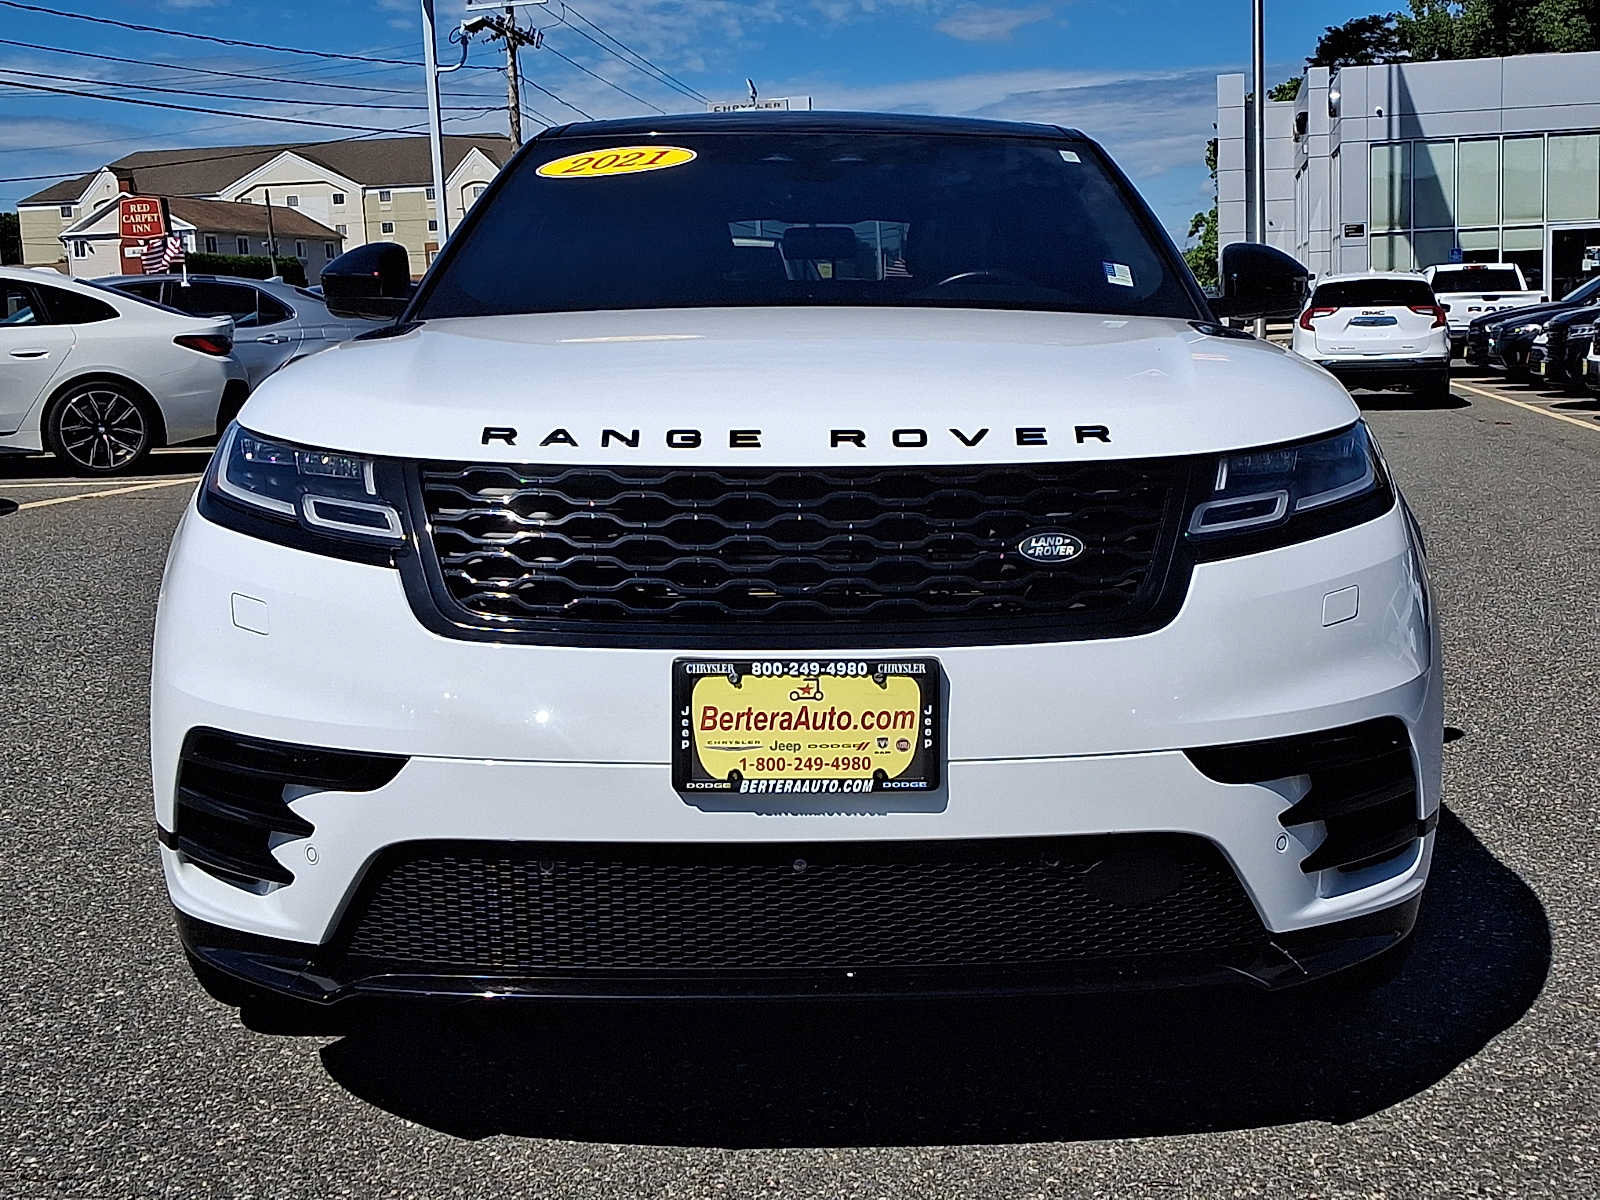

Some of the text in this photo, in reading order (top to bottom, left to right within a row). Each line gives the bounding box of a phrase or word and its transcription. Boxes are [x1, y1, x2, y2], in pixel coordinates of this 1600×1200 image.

[562, 150, 670, 174] 2021
[130, 203, 150, 213] RED
[122, 213, 159, 223] CARPET
[132, 223, 152, 233] INN
[481, 424, 1112, 449] RANGE ROVER
[1030, 536, 1064, 547] LAND
[1034, 545, 1075, 557] ROVER
[685, 663, 736, 674] CHRYSLER
[751, 661, 868, 676] 800-249-4980
[877, 663, 927, 674] CHRYSLER
[700, 705, 916, 731] BerteraAuto.com
[680, 705, 690, 750] Jeep
[923, 704, 933, 749] Jeep
[769, 740, 802, 753] Jeep
[738, 756, 872, 772] 1-800-249-4980
[739, 779, 875, 794] BERTERAAUTO.COM
[882, 781, 928, 789] DODGE
